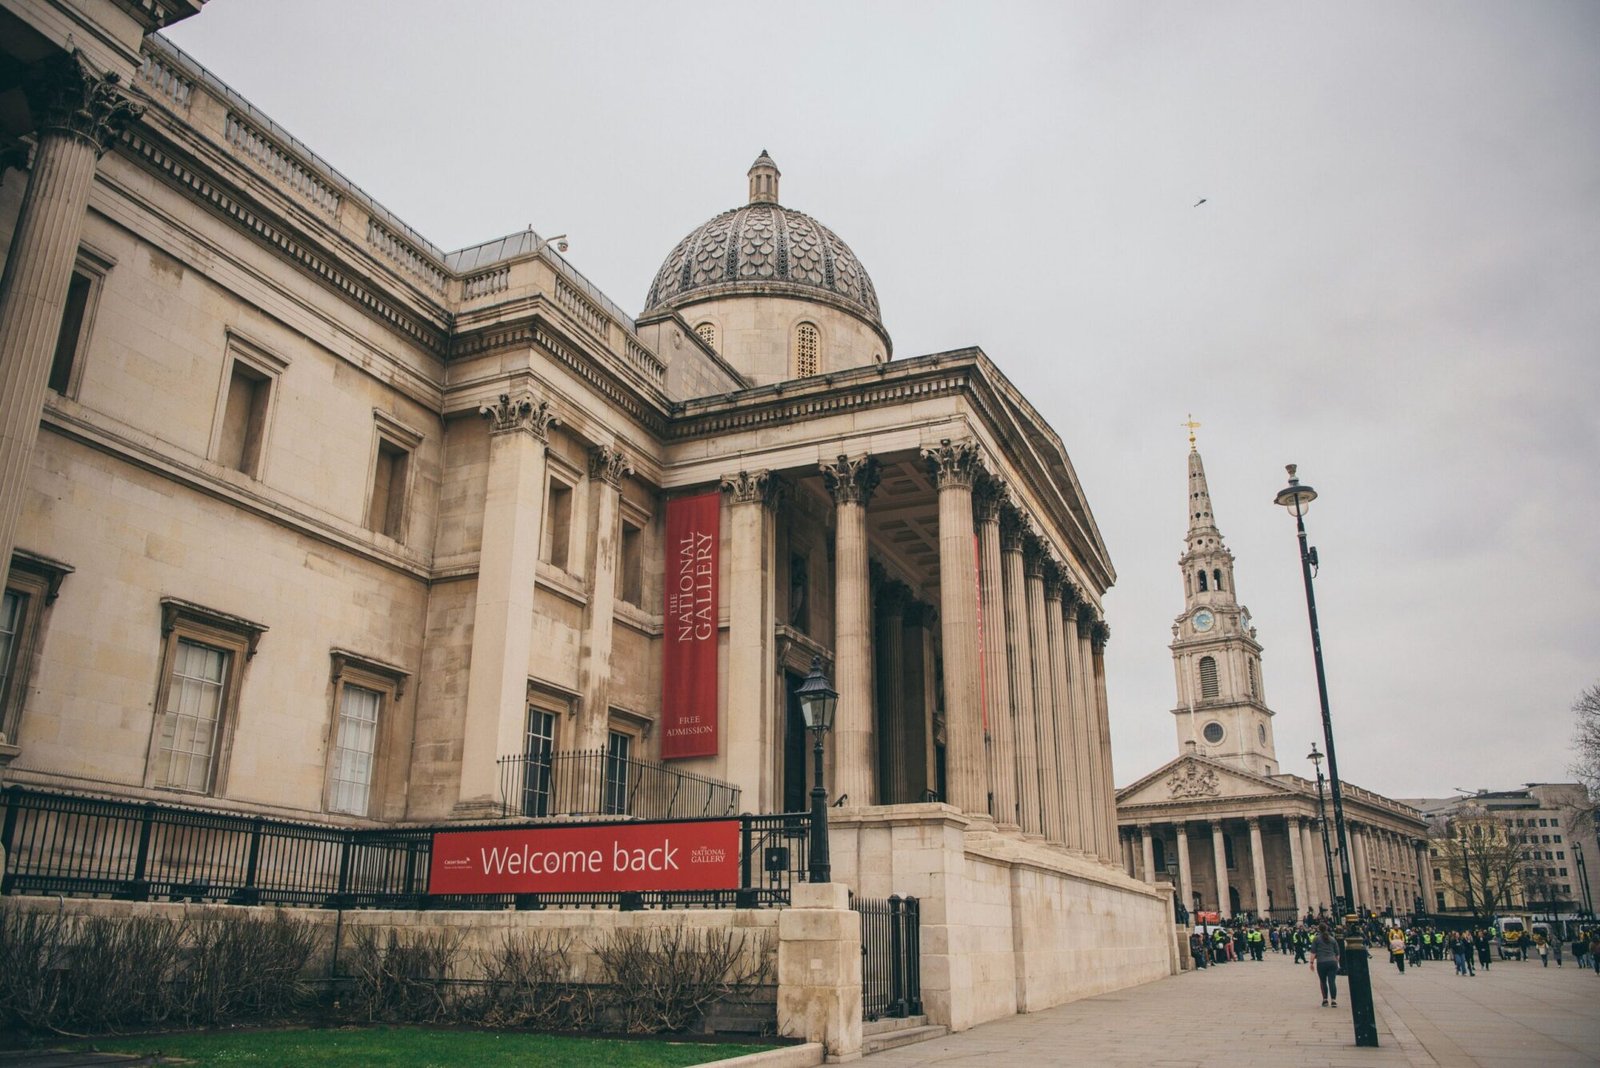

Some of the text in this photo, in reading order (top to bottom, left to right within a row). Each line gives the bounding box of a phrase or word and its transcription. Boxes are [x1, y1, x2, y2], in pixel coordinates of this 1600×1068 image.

[678, 531, 695, 642] NATIONAL
[695, 531, 713, 641] GALLERY
[670, 593, 678, 615] THE
[679, 715, 700, 725] FREE
[666, 725, 713, 737] ADMISSION
[481, 838, 680, 875] Welcome back
[690, 855, 726, 863] GALLERY
[691, 849, 726, 857] NATIONAL
